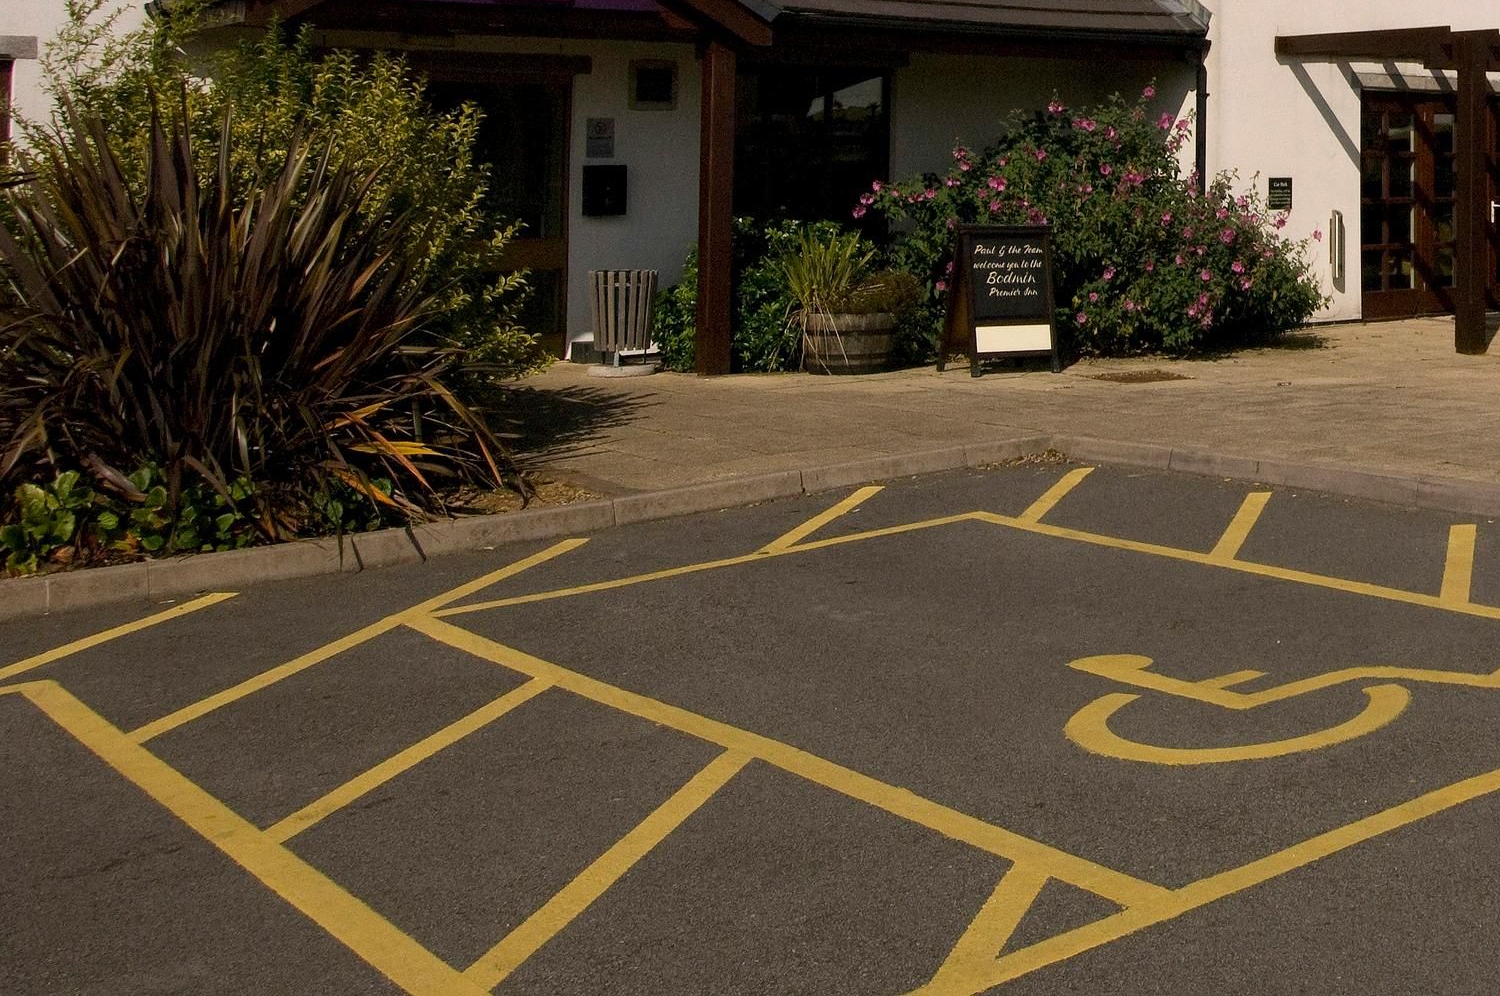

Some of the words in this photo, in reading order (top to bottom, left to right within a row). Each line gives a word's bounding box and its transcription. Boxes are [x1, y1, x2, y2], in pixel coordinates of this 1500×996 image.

[974, 244, 995, 254] Paul
[999, 245, 1006, 257] &
[1008, 245, 1021, 254] the
[1023, 244, 1043, 254] Team
[973, 260, 1005, 269] welcome
[1006, 262, 1019, 271] you
[1020, 259, 1029, 268] to
[1030, 259, 1042, 268] the
[986, 271, 1036, 284] Bodmin
[989, 287, 1021, 297] Premier
[1023, 286, 1038, 296] Inn
